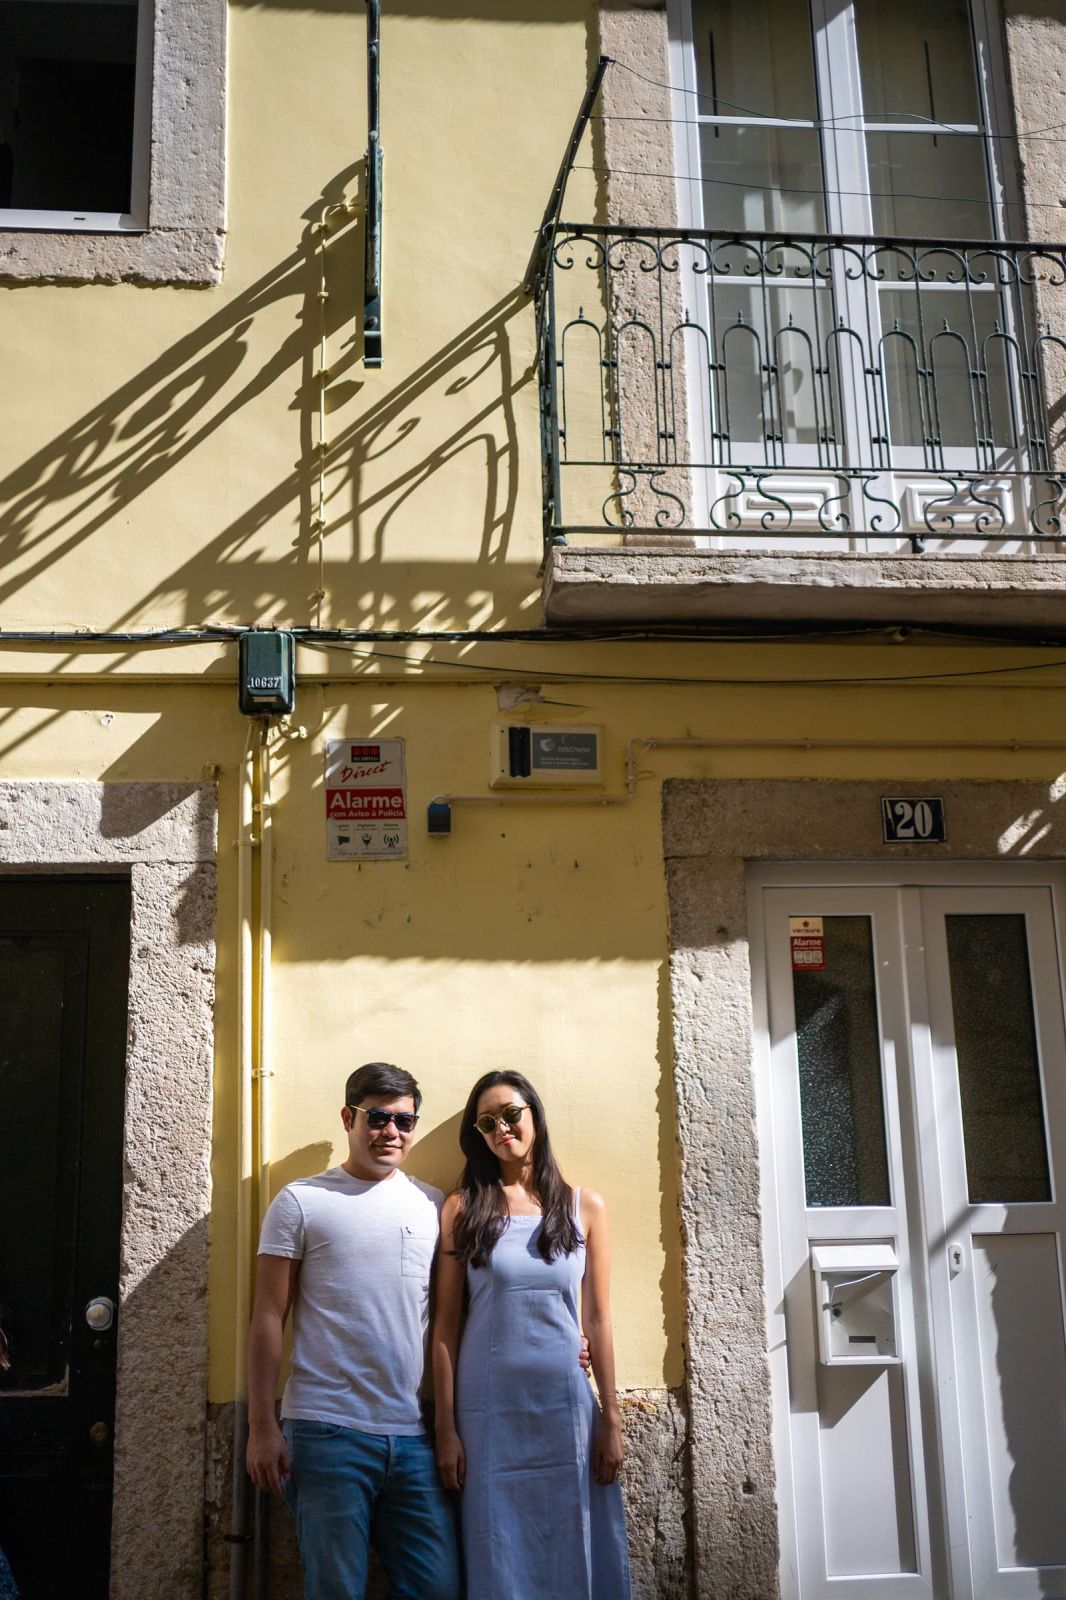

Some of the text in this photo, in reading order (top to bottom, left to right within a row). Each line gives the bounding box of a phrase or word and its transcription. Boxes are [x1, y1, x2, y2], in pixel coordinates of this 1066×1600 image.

[249, 676, 280, 688] 10637
[330, 791, 402, 808] Alarme
[330, 810, 347, 818] com
[348, 809, 370, 818] Aviso
[894, 801, 933, 838] 20
[793, 937, 822, 946] Alarme
